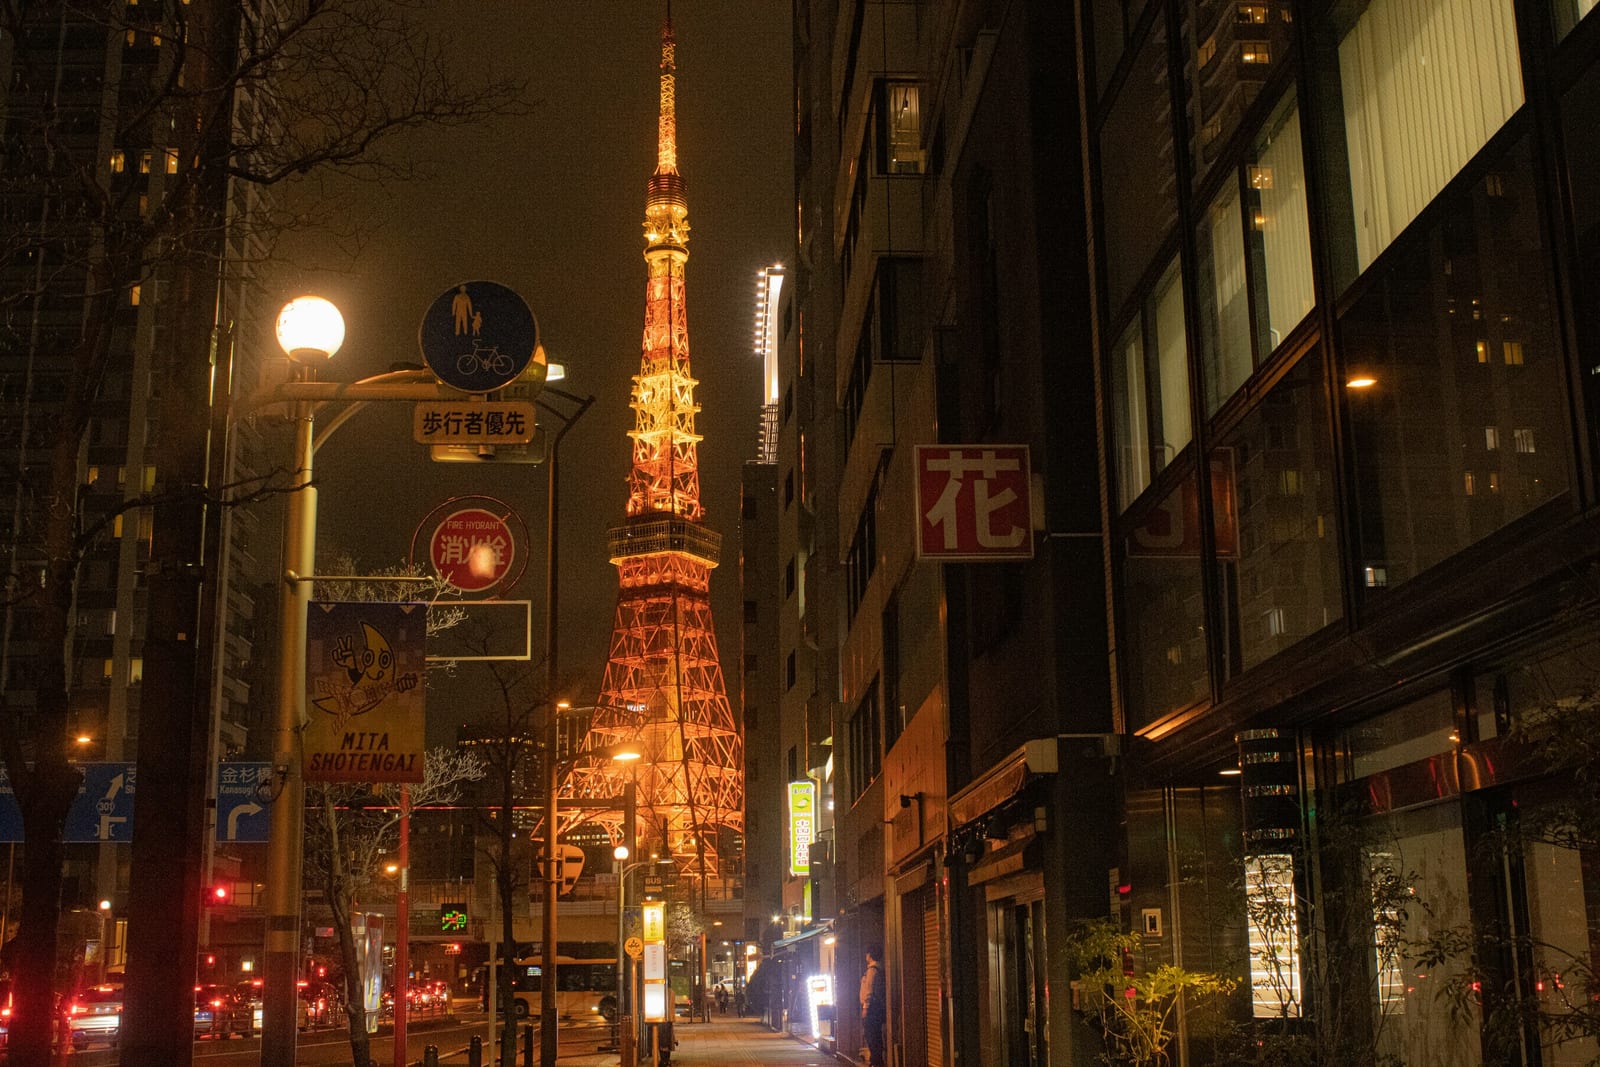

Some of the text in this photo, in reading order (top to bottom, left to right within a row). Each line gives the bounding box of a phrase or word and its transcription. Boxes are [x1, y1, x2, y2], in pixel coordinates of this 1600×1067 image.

[423, 411, 525, 436] 歩行者優先
[925, 450, 1026, 550] 花
[447, 520, 500, 531] FIRE HYDRANT
[341, 732, 389, 751] MITA
[310, 753, 417, 772] SHOTENGAI
